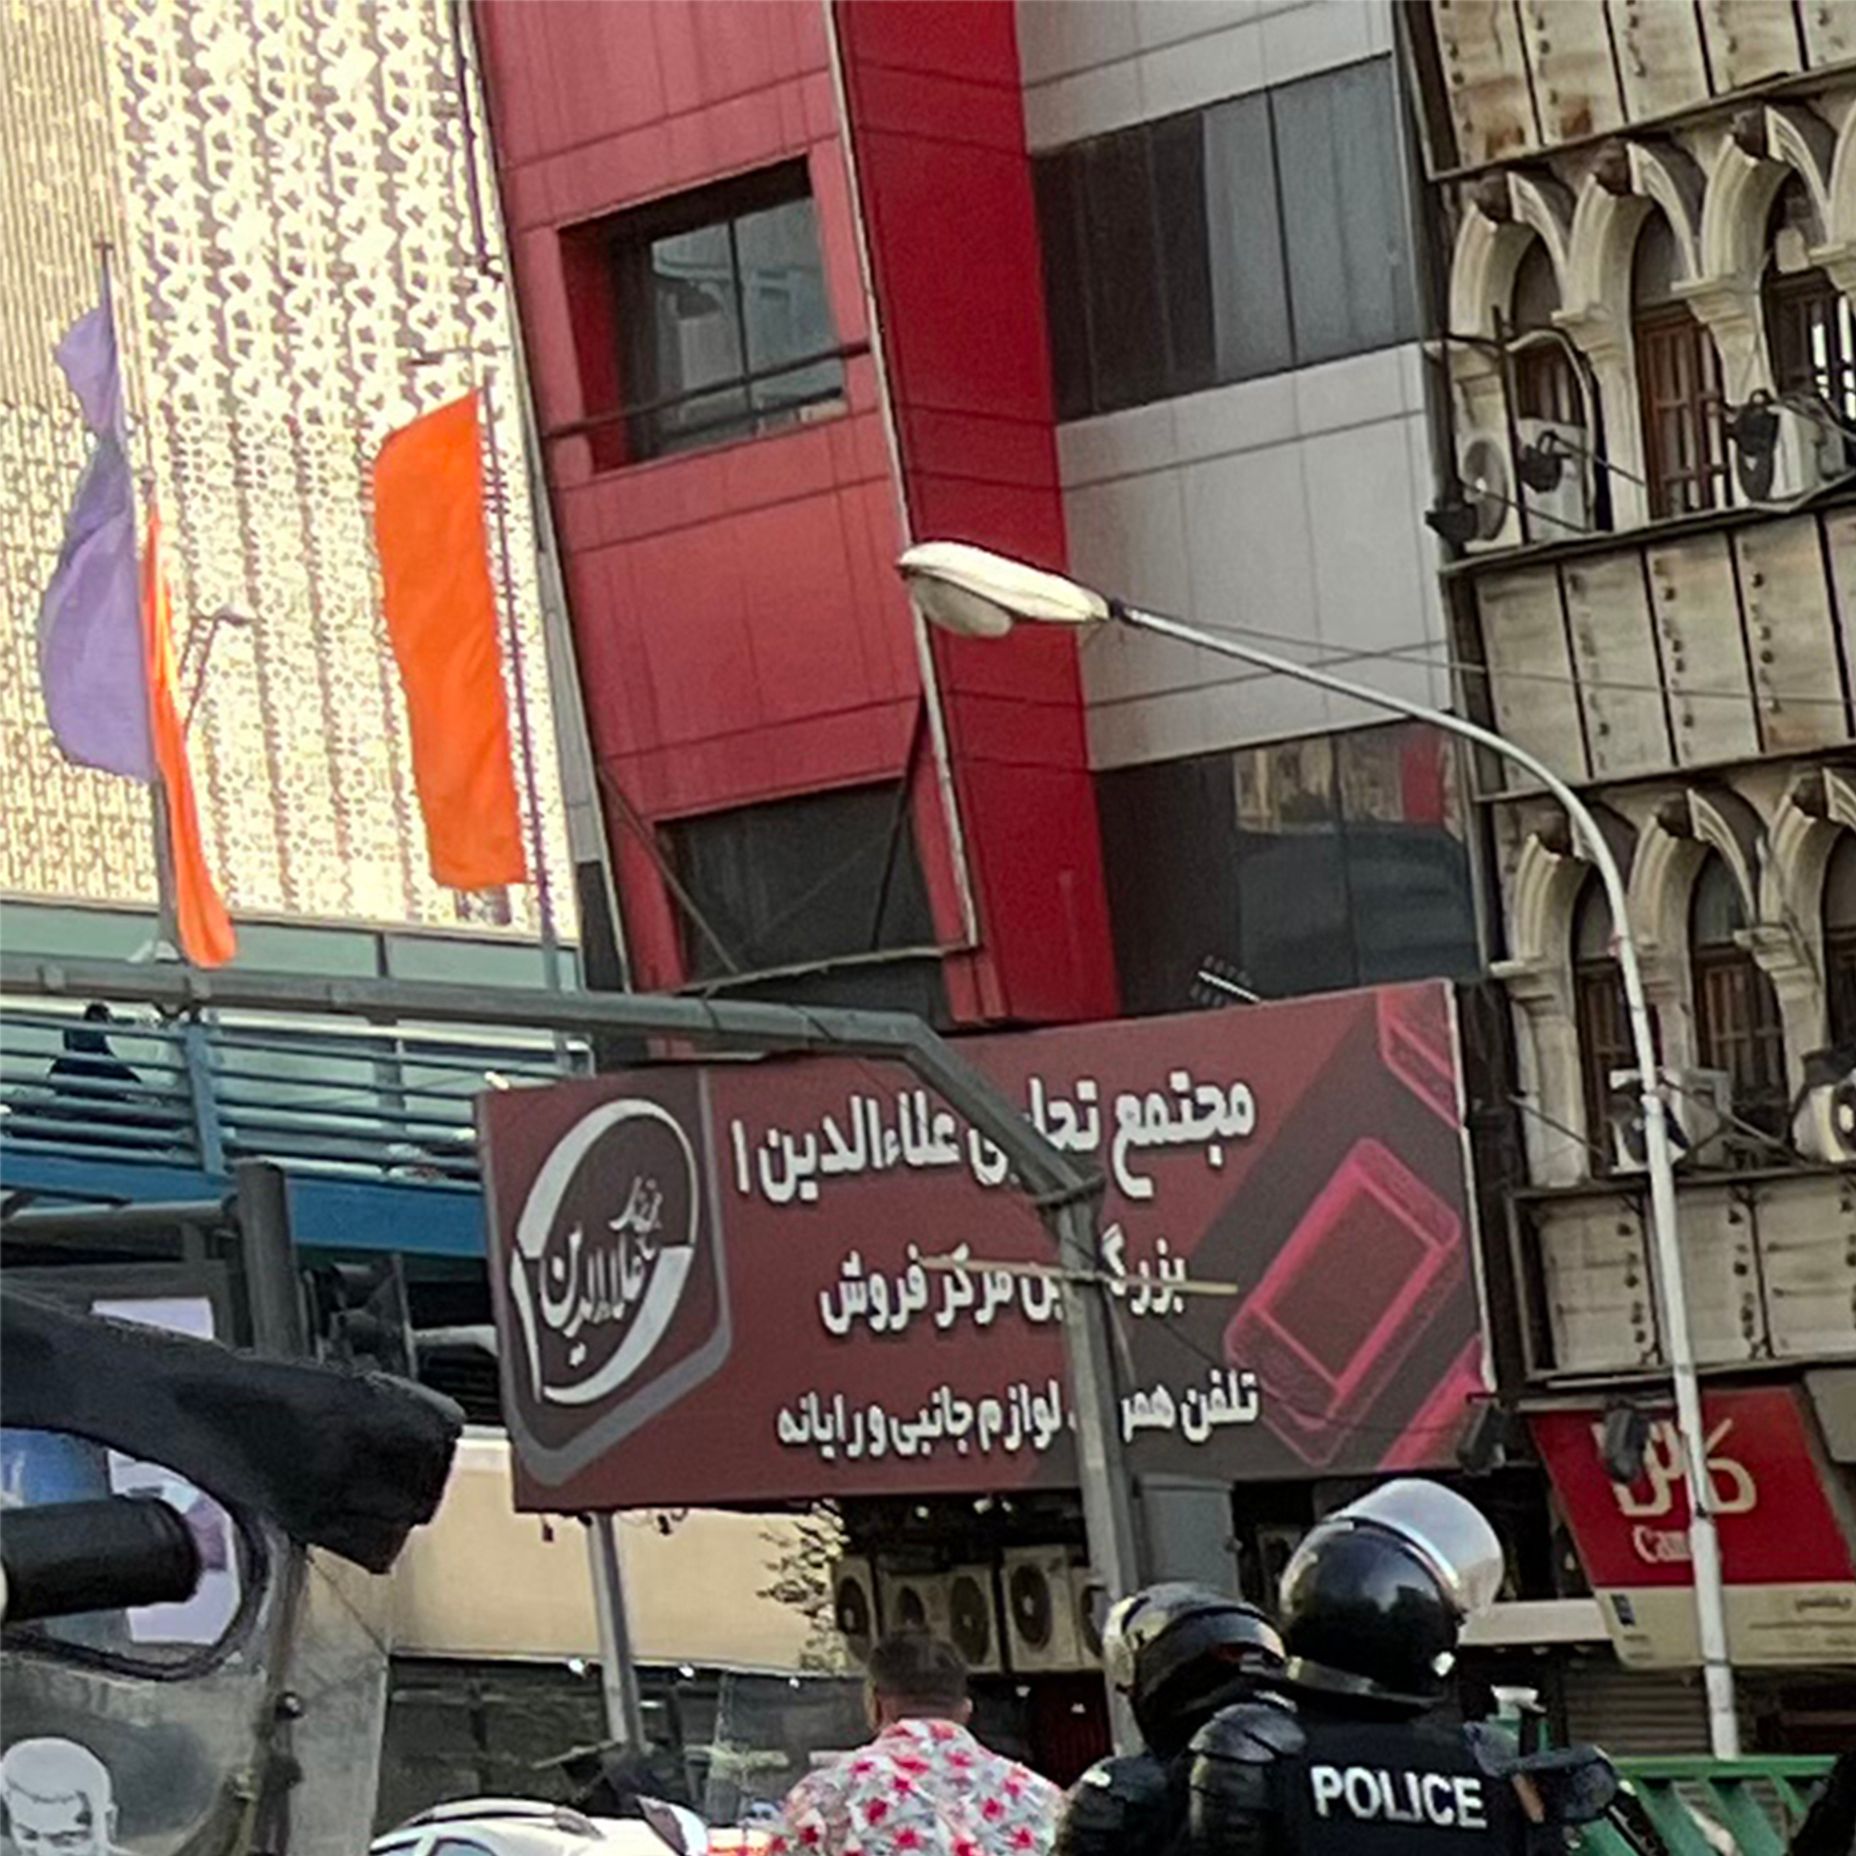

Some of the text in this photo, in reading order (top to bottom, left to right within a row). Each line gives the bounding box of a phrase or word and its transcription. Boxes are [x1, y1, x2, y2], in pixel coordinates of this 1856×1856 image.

[967, 1077, 1100, 1187] تجای
[1113, 1070, 1256, 1198] مجتمع
[820, 1243, 928, 1335] فروش
[777, 1392, 863, 1459] رایانه
[891, 1385, 974, 1456] جانبی
[978, 1379, 1062, 1451] لوازم
[1180, 1369, 1259, 1443] تلفن
[1311, 1765, 1488, 1829] POLICE
